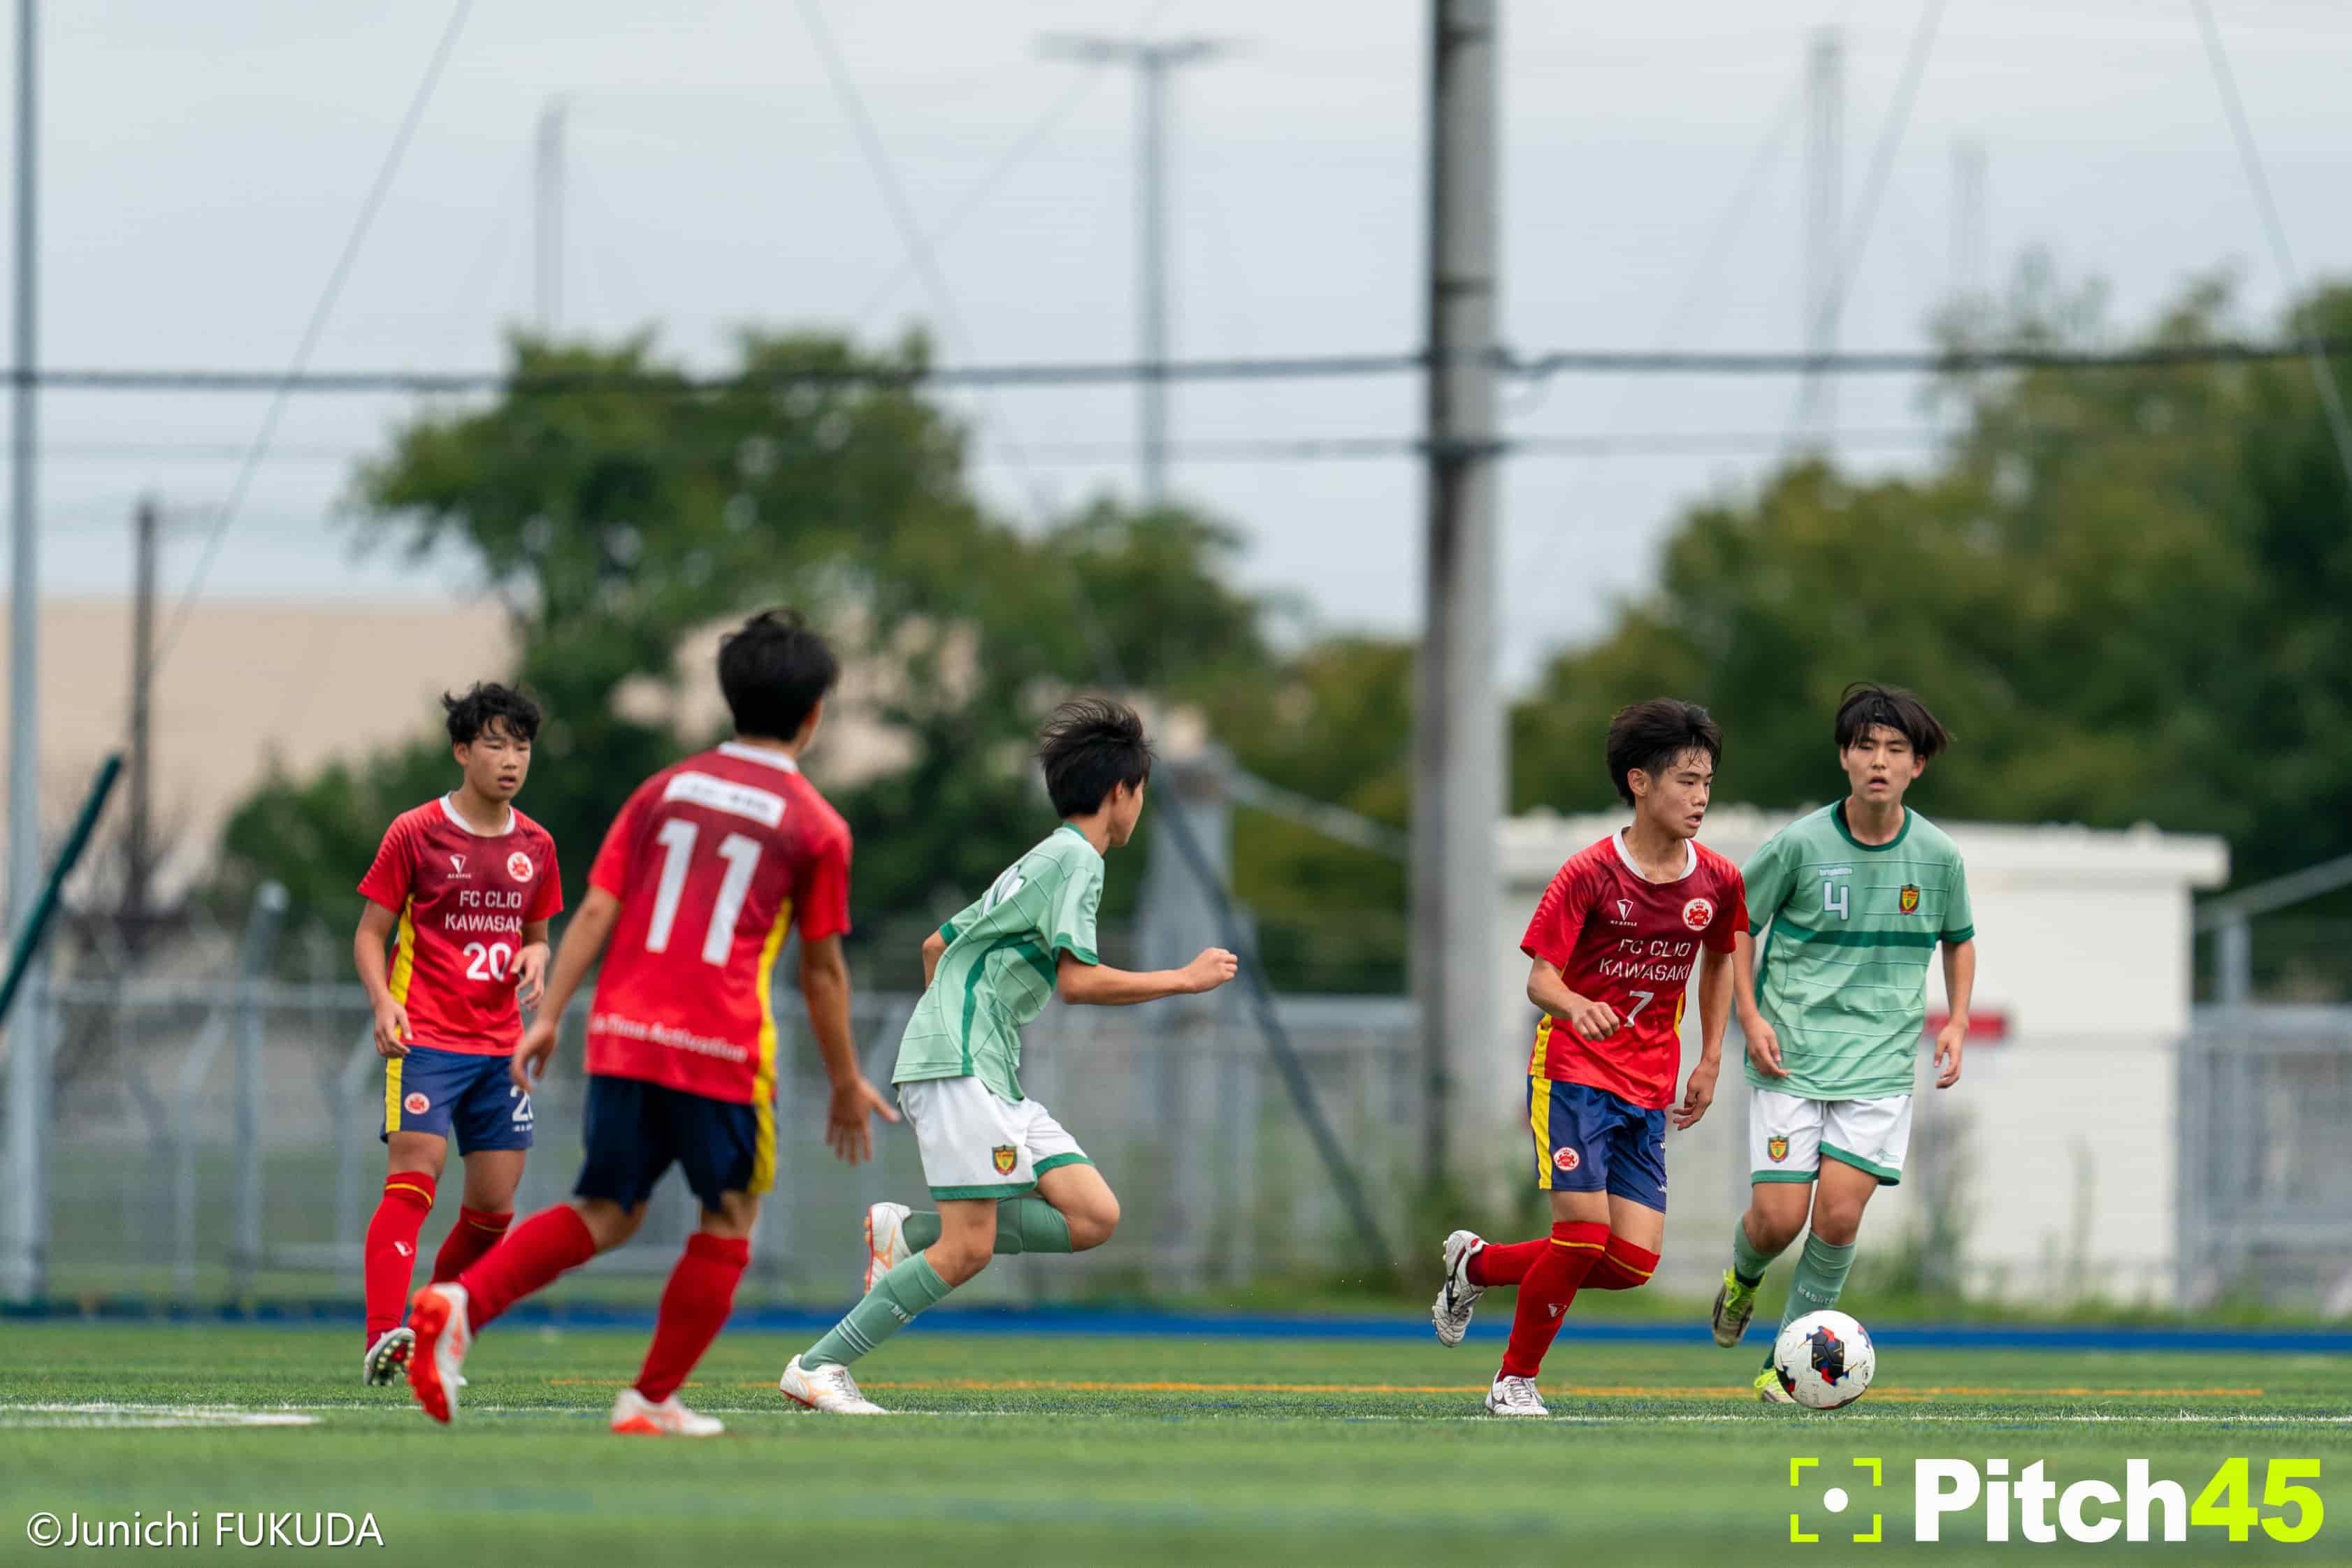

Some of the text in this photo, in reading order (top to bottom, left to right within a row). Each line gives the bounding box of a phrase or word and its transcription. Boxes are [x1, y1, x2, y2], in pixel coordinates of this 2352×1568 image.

[459, 890, 522, 909] FC CLIO
[647, 818, 763, 968] 11
[1822, 881, 1850, 922] 4
[445, 913, 523, 932] KAWASAK
[463, 942, 512, 982] 20
[1618, 938, 1691, 957] FC CLIO
[1599, 958, 1691, 981] KAWASAKI
[1624, 990, 1655, 1027] 7
